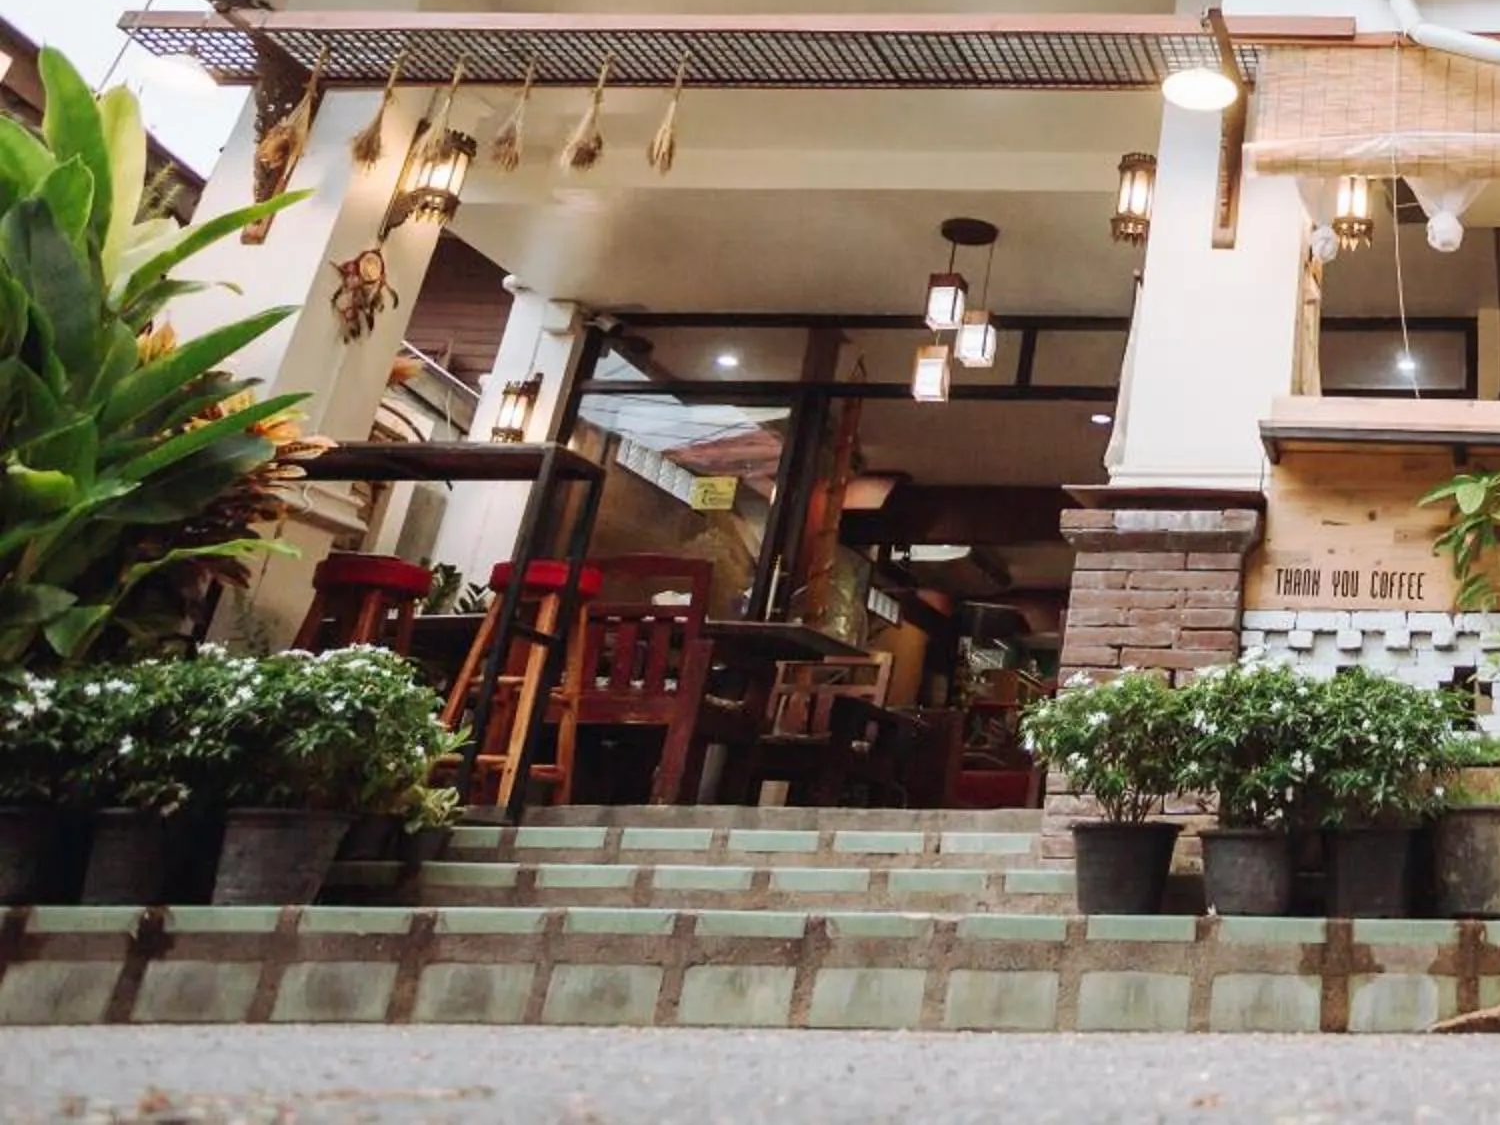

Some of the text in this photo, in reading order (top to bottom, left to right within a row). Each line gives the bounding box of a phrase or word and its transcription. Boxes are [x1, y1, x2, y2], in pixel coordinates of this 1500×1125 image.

[1276, 568, 1426, 600] THANK YOU COFFEE
